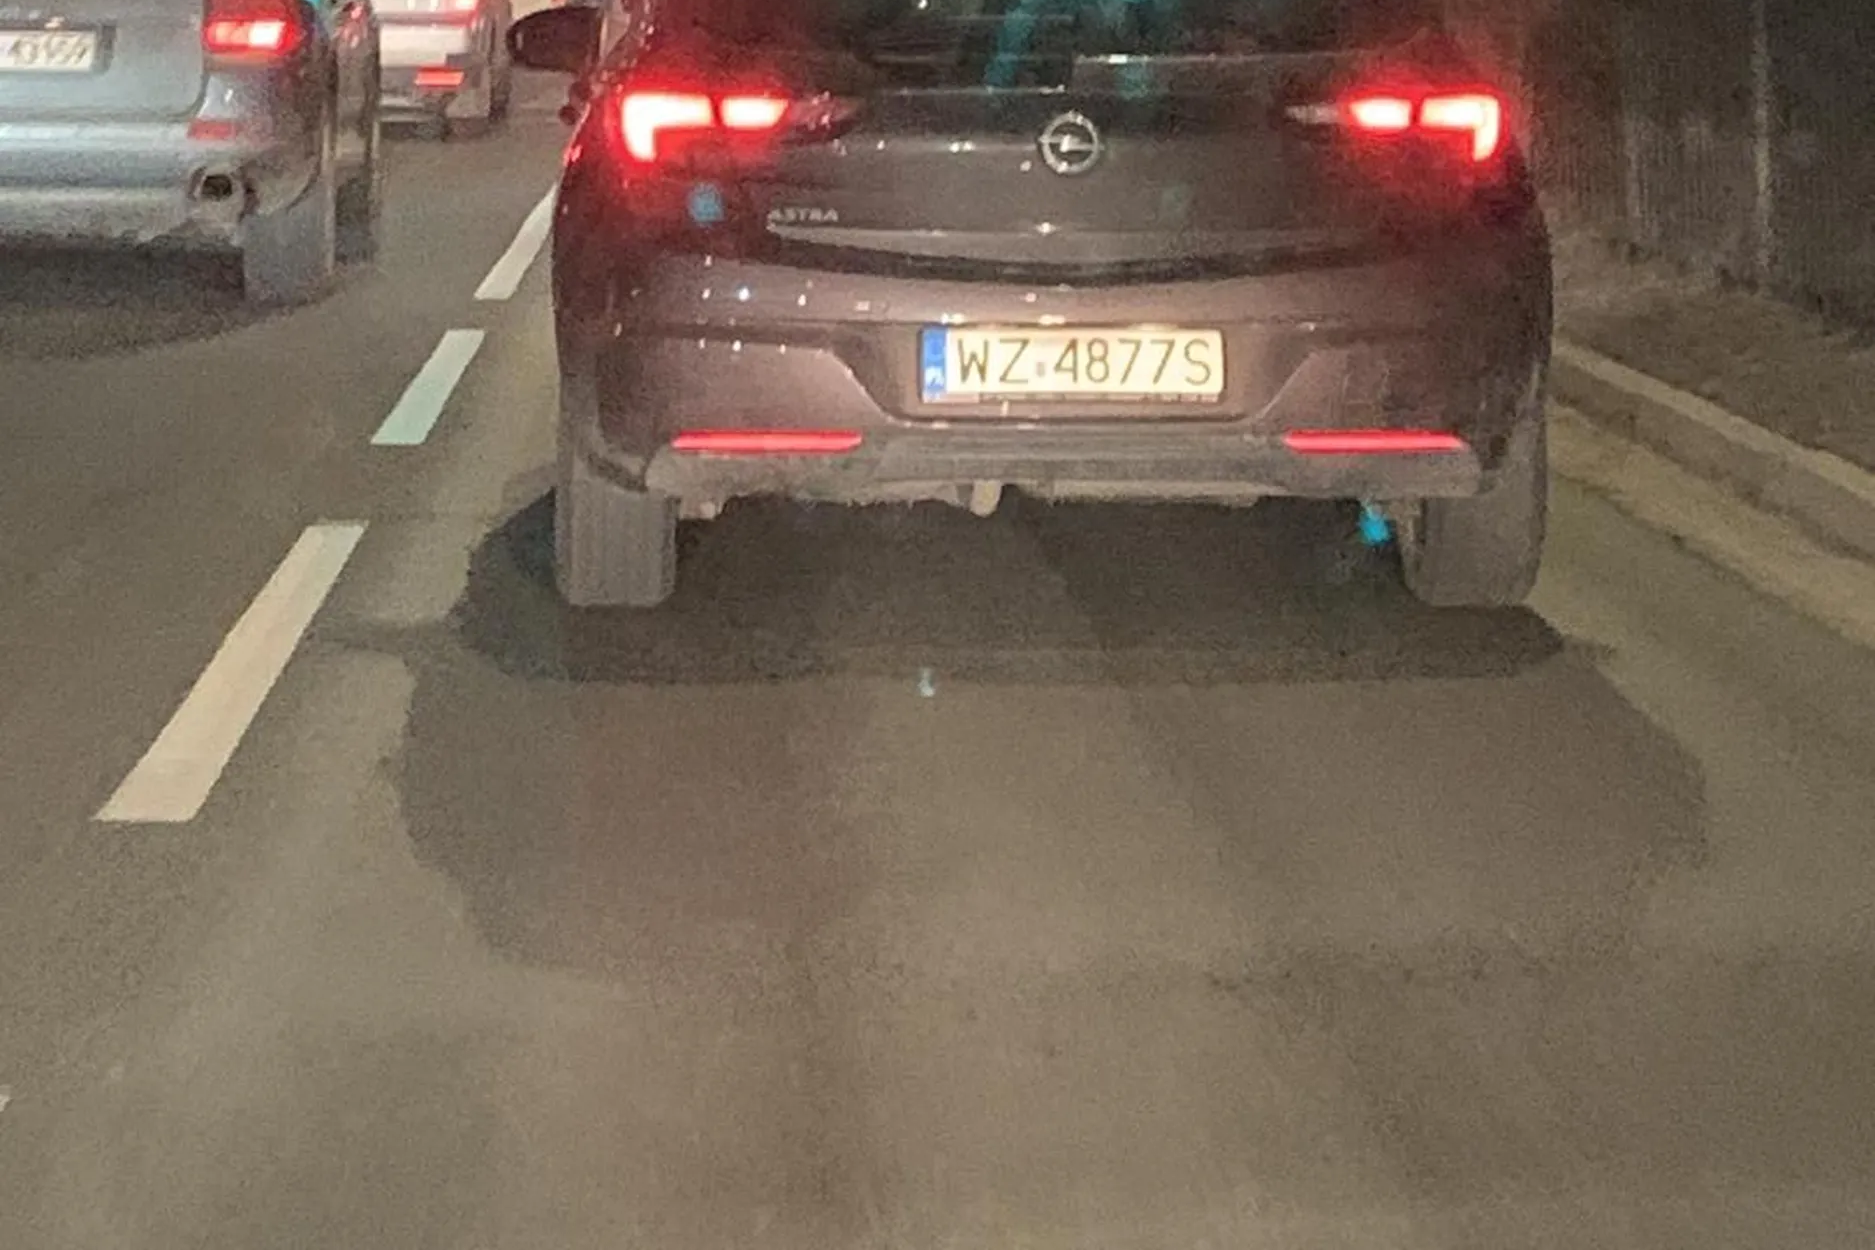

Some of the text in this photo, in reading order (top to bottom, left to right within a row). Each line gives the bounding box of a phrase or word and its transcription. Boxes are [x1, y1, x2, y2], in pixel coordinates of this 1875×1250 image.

[767, 207, 838, 222] ASTRA
[957, 337, 1212, 386] WZ 4877S
